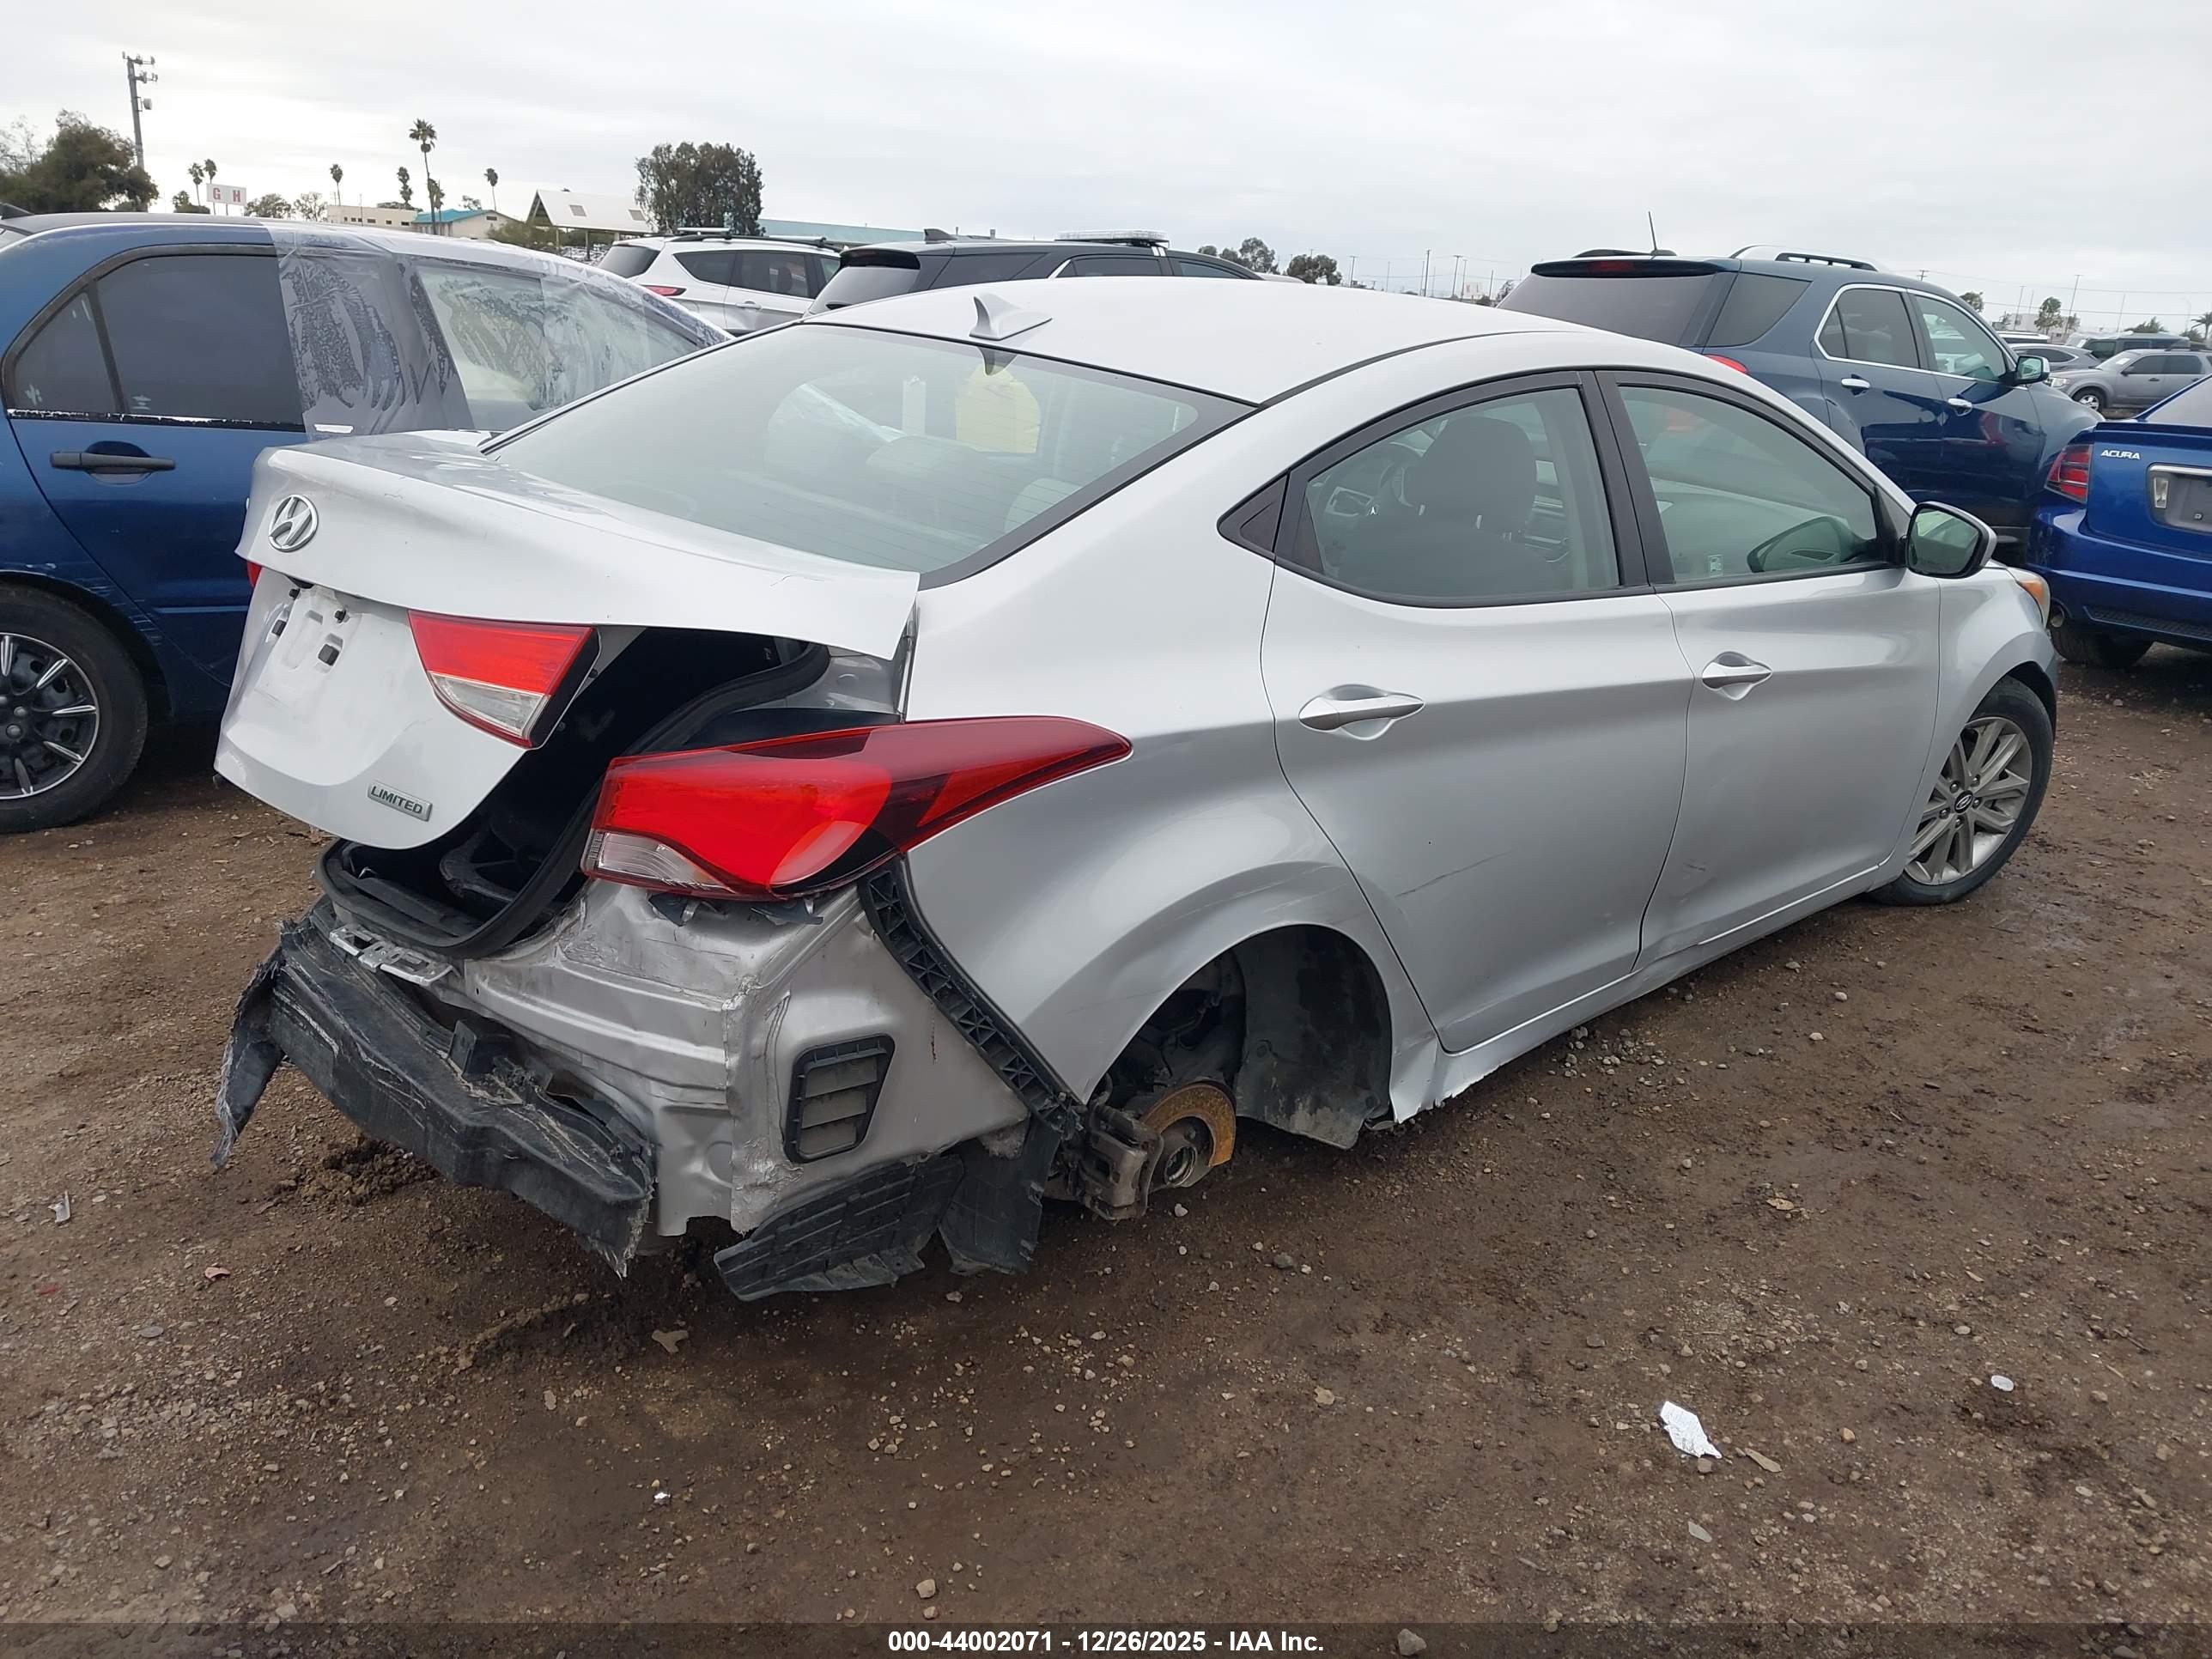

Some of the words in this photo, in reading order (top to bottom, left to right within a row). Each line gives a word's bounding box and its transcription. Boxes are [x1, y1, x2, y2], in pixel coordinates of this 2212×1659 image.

[233, 190, 240, 203] H
[2100, 449, 2141, 460] ACURA
[370, 786, 423, 814] LIMITED
